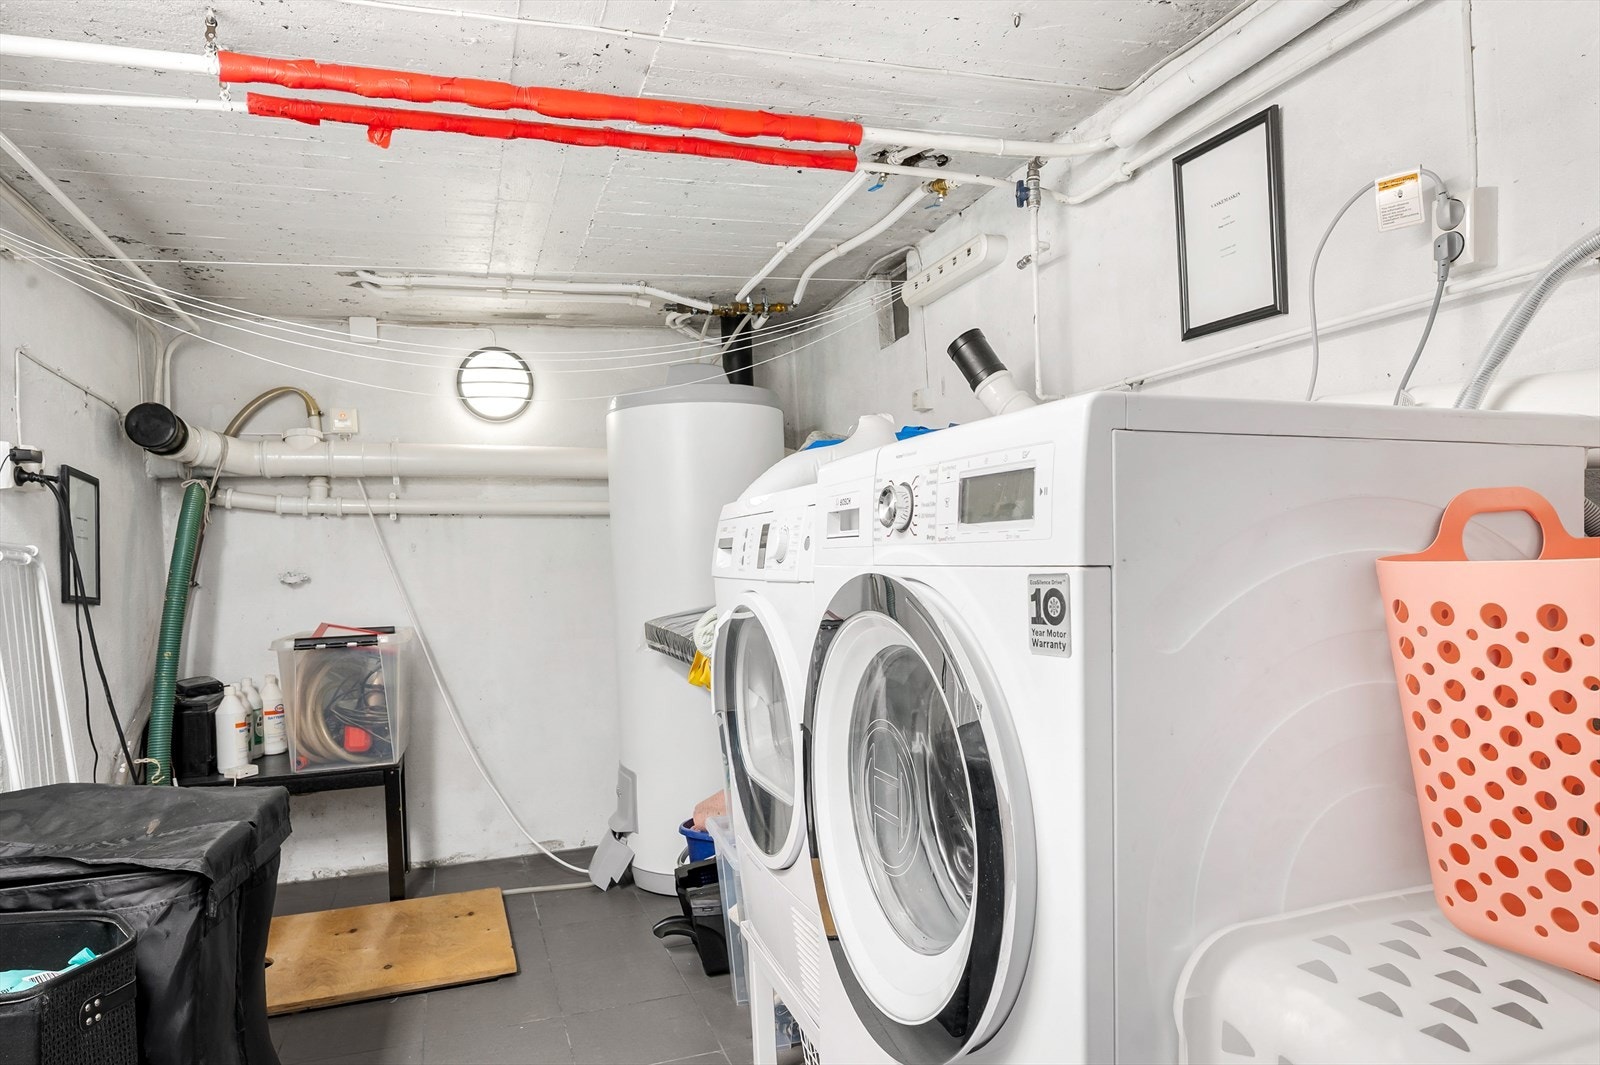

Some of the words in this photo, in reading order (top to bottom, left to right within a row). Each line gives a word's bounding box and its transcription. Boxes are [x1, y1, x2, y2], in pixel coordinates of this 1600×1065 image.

[840, 497, 852, 507] BOSCH
[1030, 588, 1066, 626] 10
[1031, 629, 1045, 637] Year
[1046, 629, 1067, 638] Motor
[1031, 638, 1067, 652] Warranty
